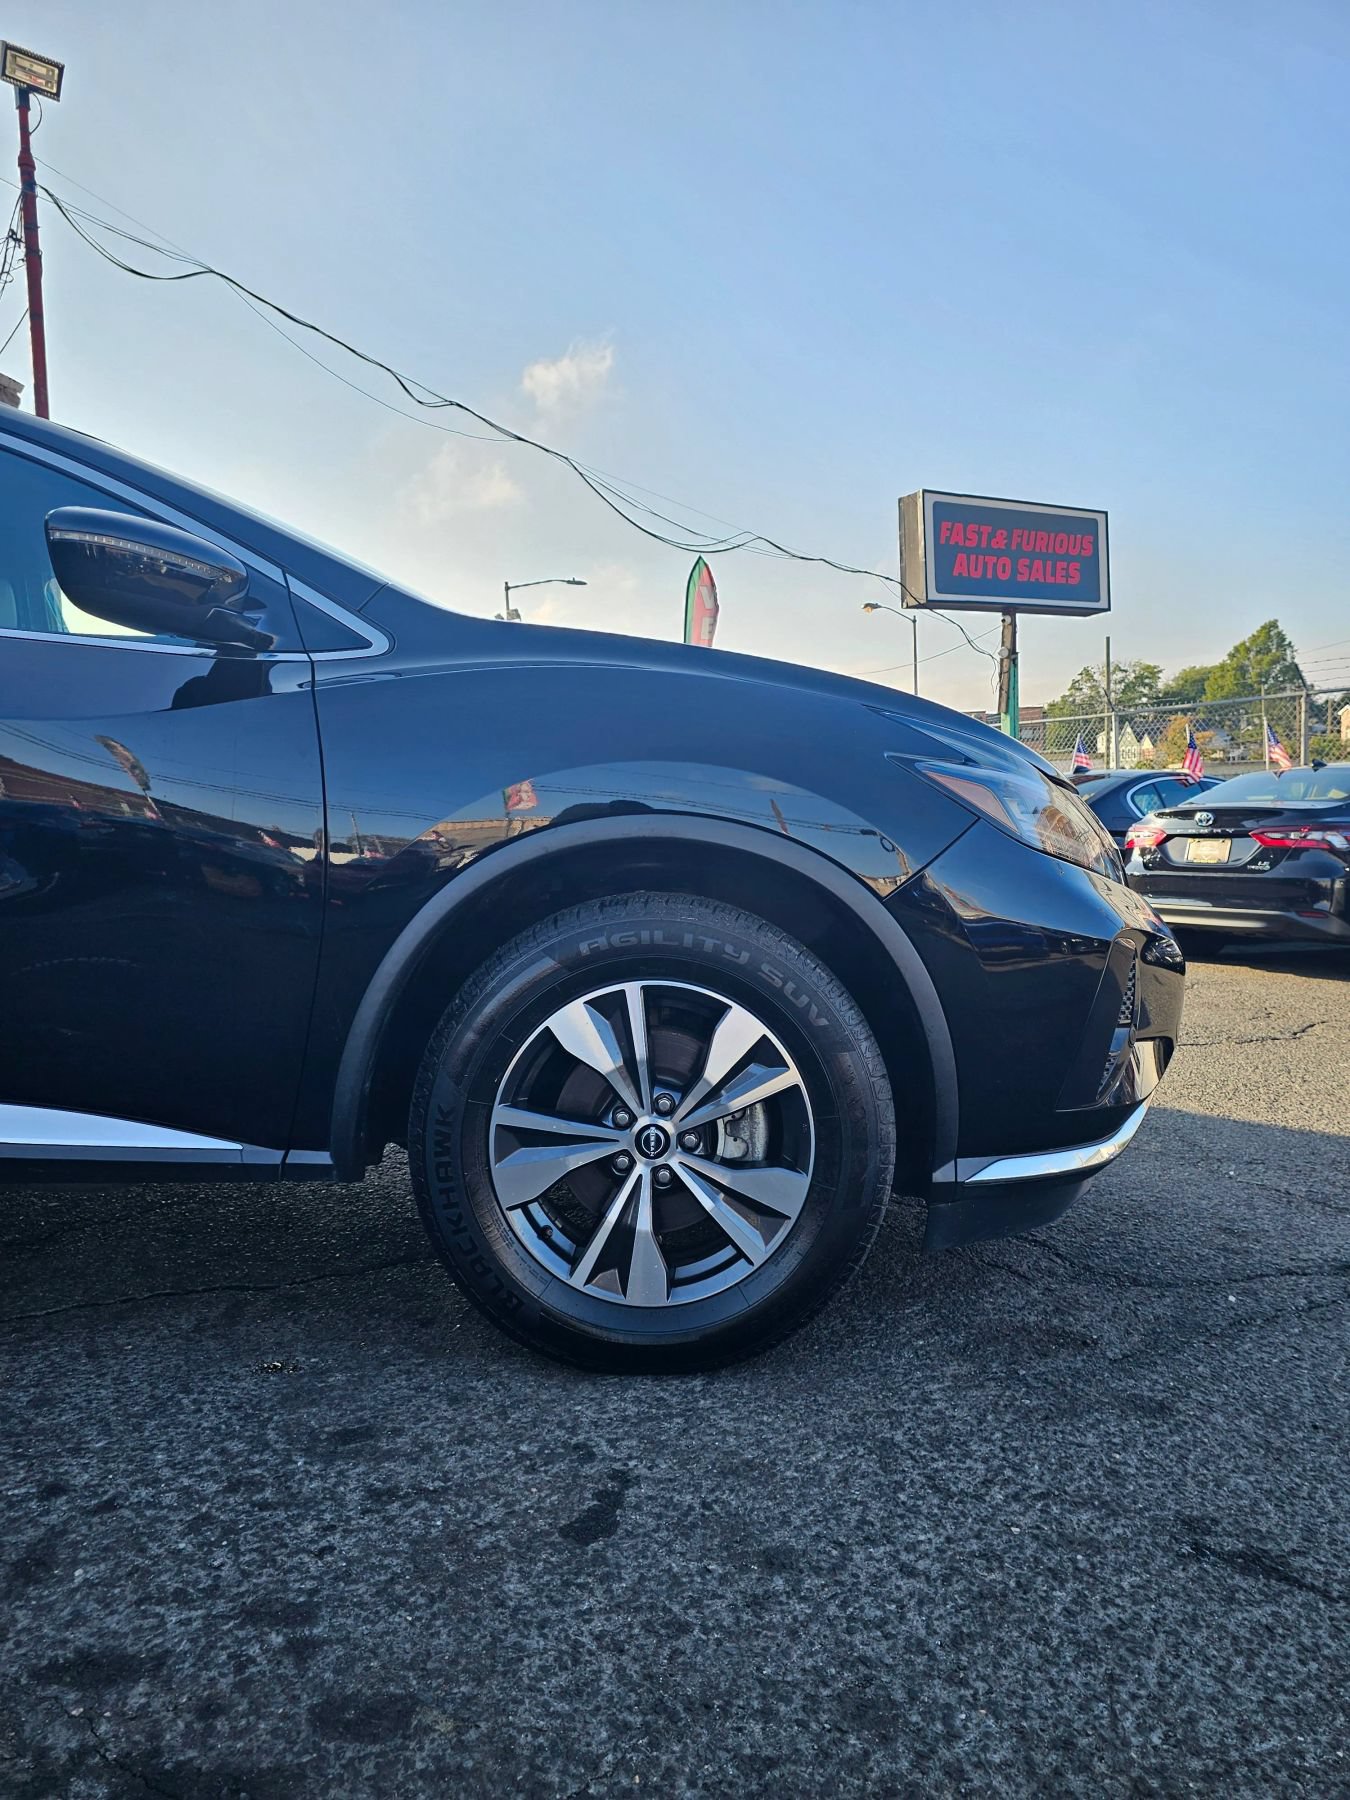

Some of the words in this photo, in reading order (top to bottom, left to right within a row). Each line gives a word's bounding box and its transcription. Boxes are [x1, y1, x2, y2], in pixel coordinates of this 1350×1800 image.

[940, 521, 992, 548] FAST
[1010, 529, 1093, 556] FURIOUS
[953, 552, 1011, 580] AUTO
[1017, 559, 1080, 584] SALES
[579, 929, 750, 965] AGILITY
[757, 962, 829, 1027] SUV
[433, 1103, 526, 1313] BLACKHAWK
